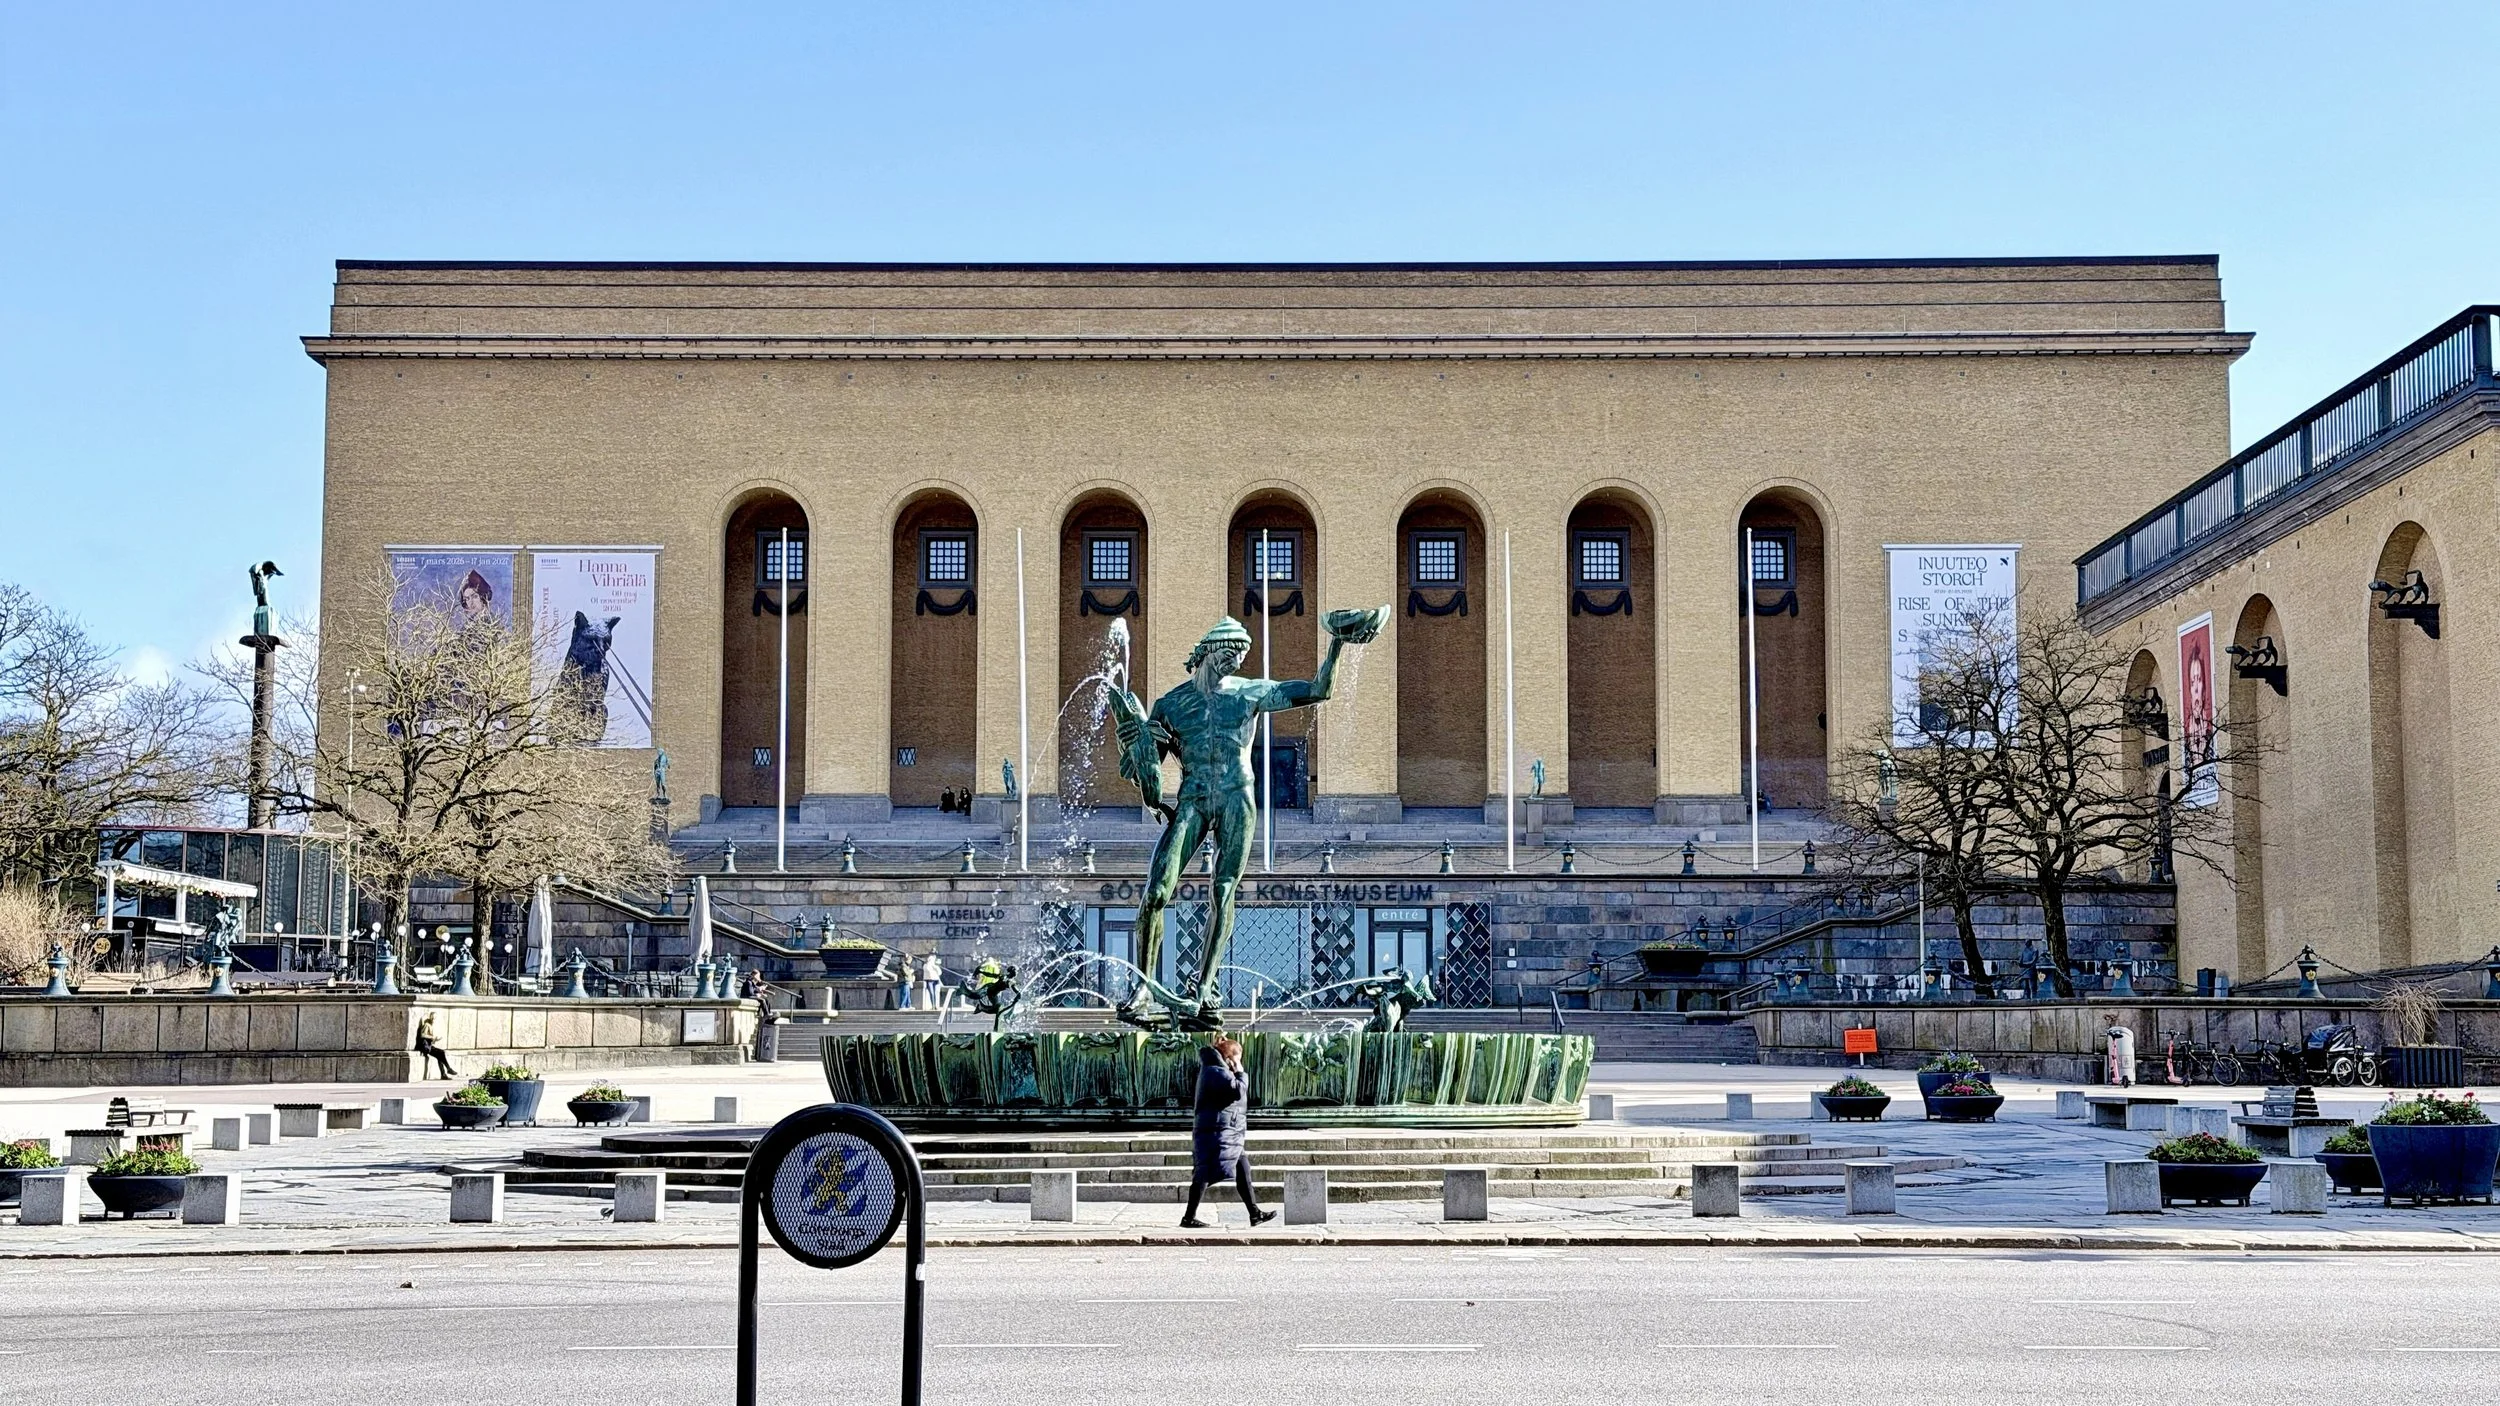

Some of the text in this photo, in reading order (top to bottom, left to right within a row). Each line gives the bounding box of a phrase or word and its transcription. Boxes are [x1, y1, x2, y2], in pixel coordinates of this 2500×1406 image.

[579, 559, 627, 573] Hanna
[1918, 556, 1988, 573] INUUTEQ
[592, 573, 647, 587] Vihriälä
[1922, 573, 1984, 586] STORCH
[1898, 597, 2010, 611] RISE OF THE
[1255, 883, 1434, 901] KONSTMUSEUM
[930, 909, 1005, 920] HASSELBLAD
[1381, 909, 1419, 920] entré
